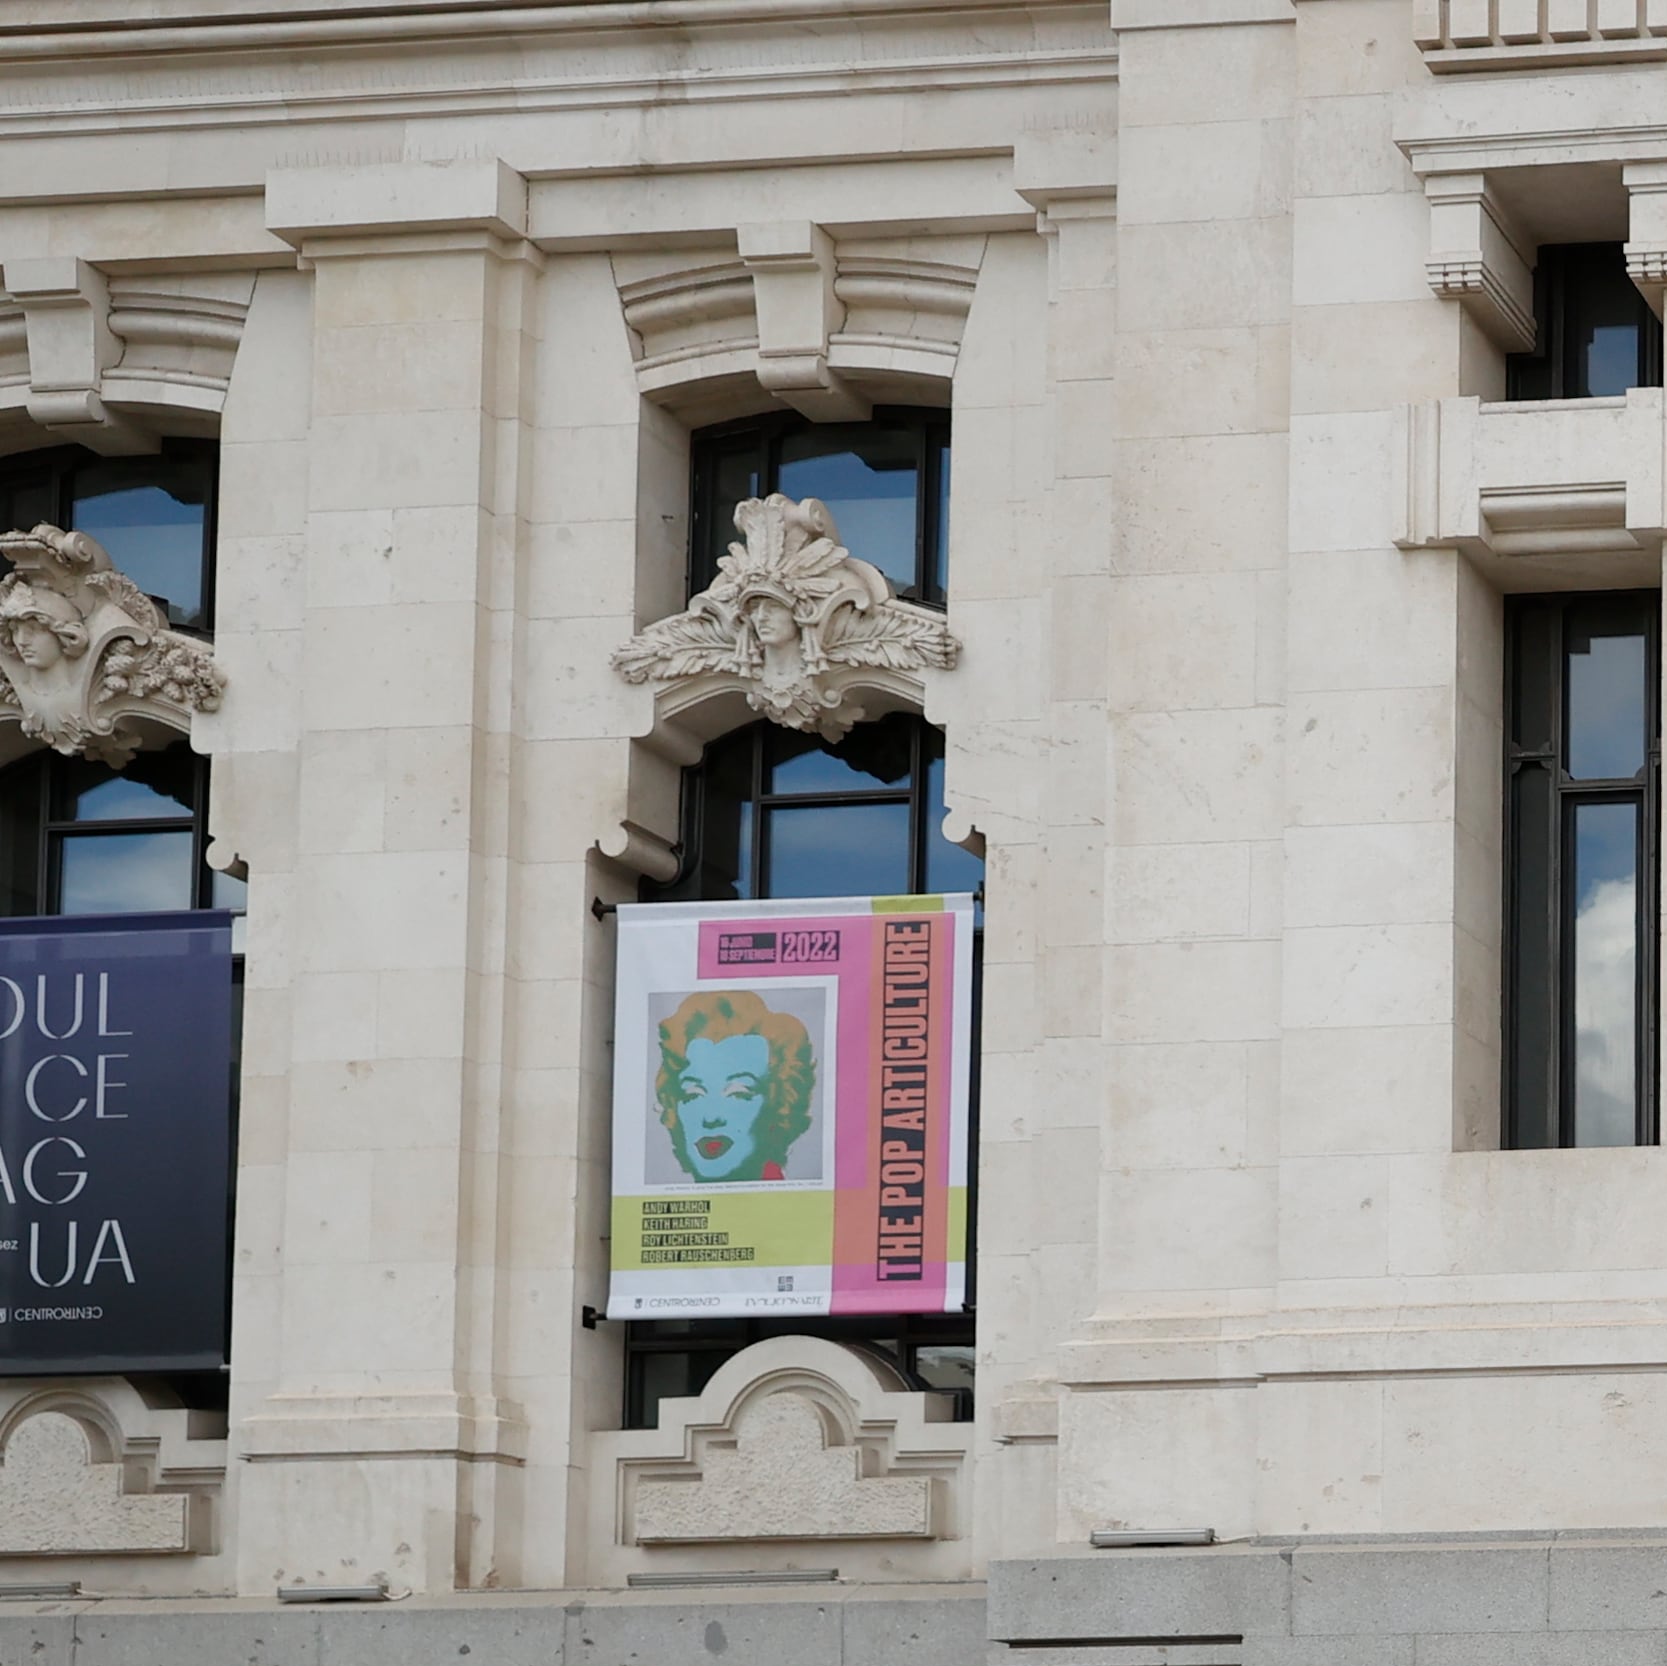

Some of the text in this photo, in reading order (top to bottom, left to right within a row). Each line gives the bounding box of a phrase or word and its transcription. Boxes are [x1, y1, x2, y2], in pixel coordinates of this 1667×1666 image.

[783, 931, 838, 962] 2022
[879, 922, 930, 1280] THE POP ART CULTURE
[643, 1201, 710, 1214] ANDY WARHOL
[643, 1217, 708, 1230] KEITH HARING
[643, 1232, 728, 1246] ROY LICHTENSTEIN
[642, 1247, 754, 1263] ROBERT RAUSCHENBERG
